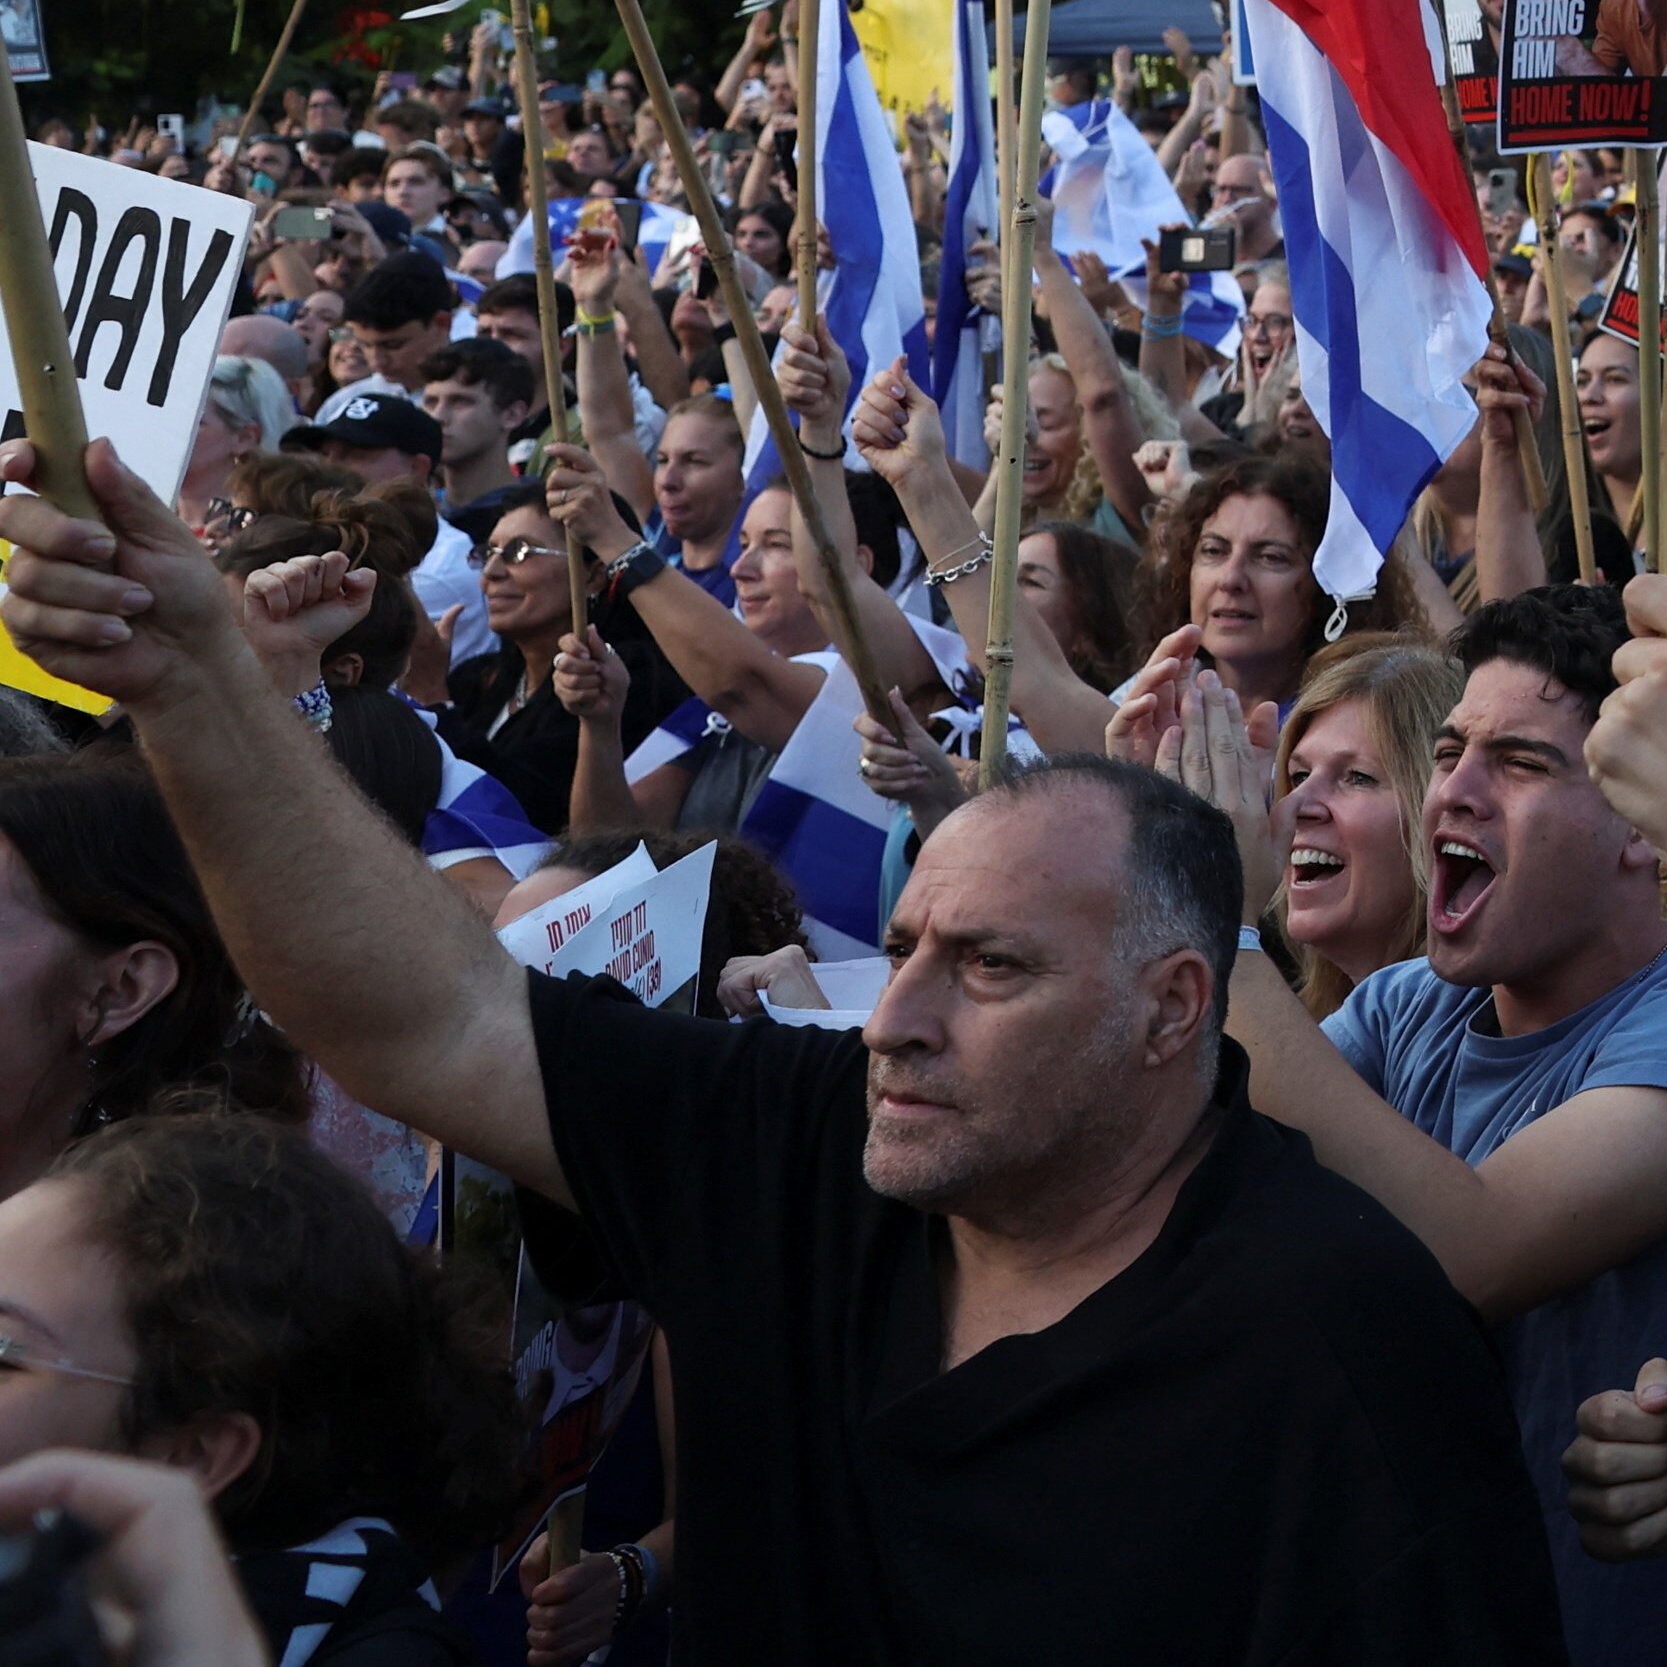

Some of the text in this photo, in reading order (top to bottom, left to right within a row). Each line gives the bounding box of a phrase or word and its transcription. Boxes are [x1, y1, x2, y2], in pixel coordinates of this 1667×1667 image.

[1447, 14, 1483, 42] BRING
[1451, 43, 1476, 76] HIM
[1512, 40, 1556, 80] HIM
[1511, 86, 1573, 125] HOME
[1579, 79, 1651, 122] NOW!
[632, 898, 647, 936] דוד
[633, 929, 655, 974] CUNIO
